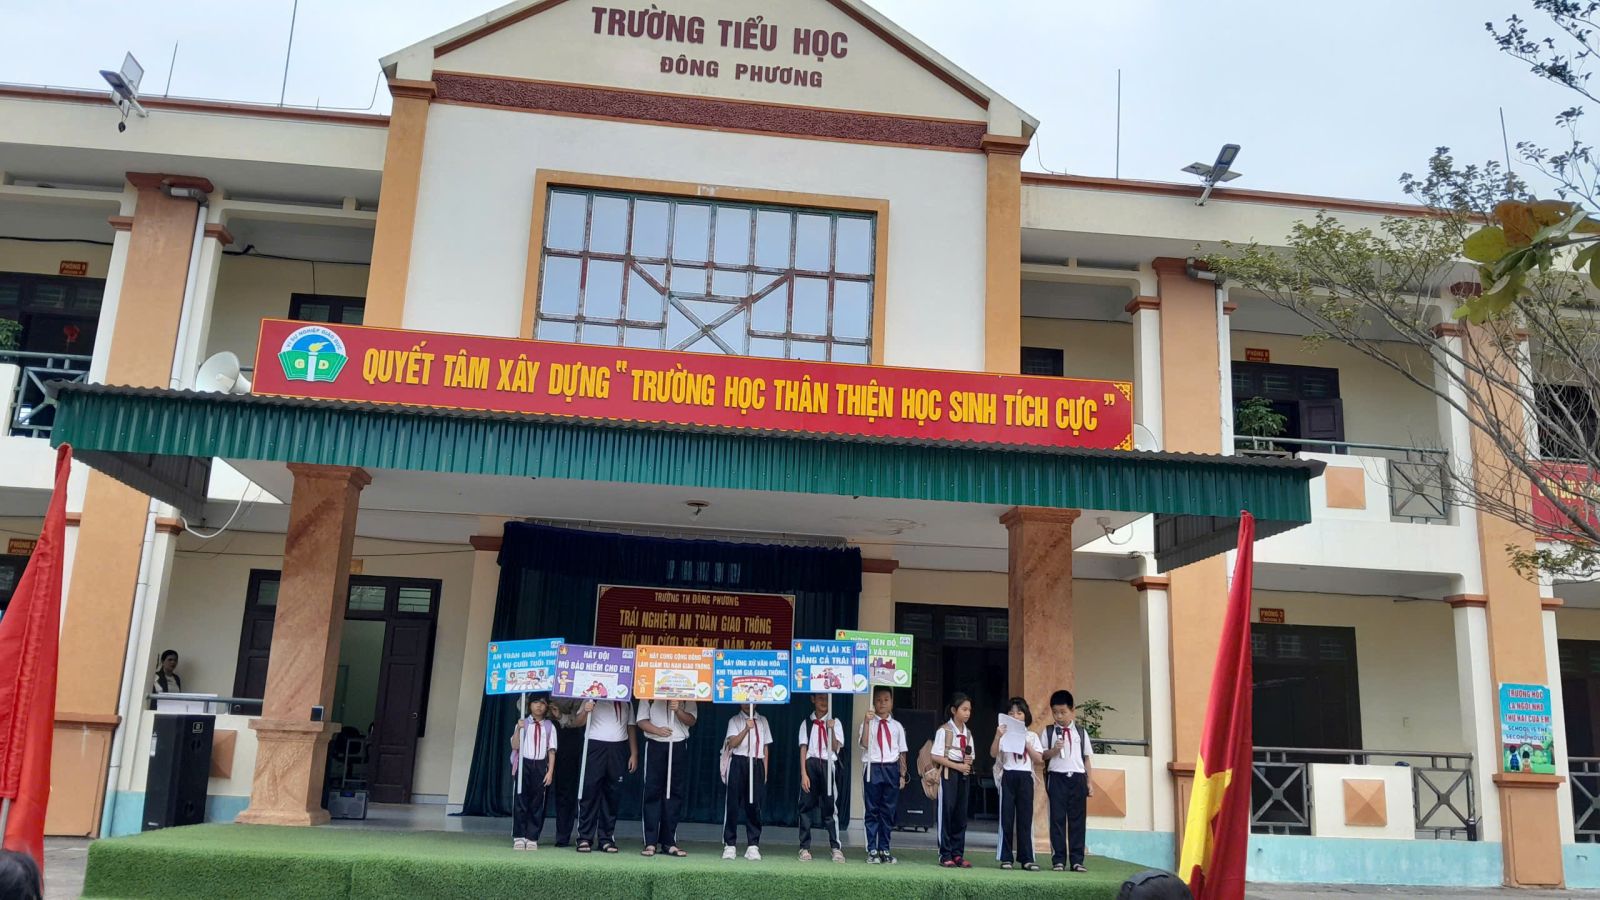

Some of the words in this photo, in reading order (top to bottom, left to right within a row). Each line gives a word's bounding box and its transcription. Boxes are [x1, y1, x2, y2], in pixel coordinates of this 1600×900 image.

[591, 4, 705, 45] TRƯỜNG
[718, 15, 778, 51] TIỂU
[793, 27, 848, 62] HỌC
[660, 54, 719, 78] ĐÔNG
[735, 63, 822, 88] PHƯƠNG
[363, 340, 435, 385] QUYẾT
[443, 349, 491, 390] TÂM
[496, 354, 540, 394] XÂY
[548, 360, 611, 403] DỰNG
[724, 376, 766, 415] HỌC
[773, 374, 830, 414] THÂN
[835, 379, 894, 423] THIỆN
[901, 388, 943, 427] HỌC
[949, 391, 997, 425] SINH
[1003, 388, 1049, 427] TÍCH
[620, 606, 639, 627] TRẢI
[642, 610, 676, 631] NGHIỆM
[679, 614, 692, 631] AN
[695, 612, 718, 632] TOÀN
[721, 616, 741, 633] GIAO
[744, 616, 772, 635] THÔNG
[538, 649, 557, 657] THÔN
[810, 645, 825, 653] HÃY
[827, 645, 839, 653] LÁI
[873, 648, 888, 657] VĂN
[832, 656, 849, 665] TRÁI
[851, 657, 865, 665] TIM
[604, 664, 619, 672] CHO
